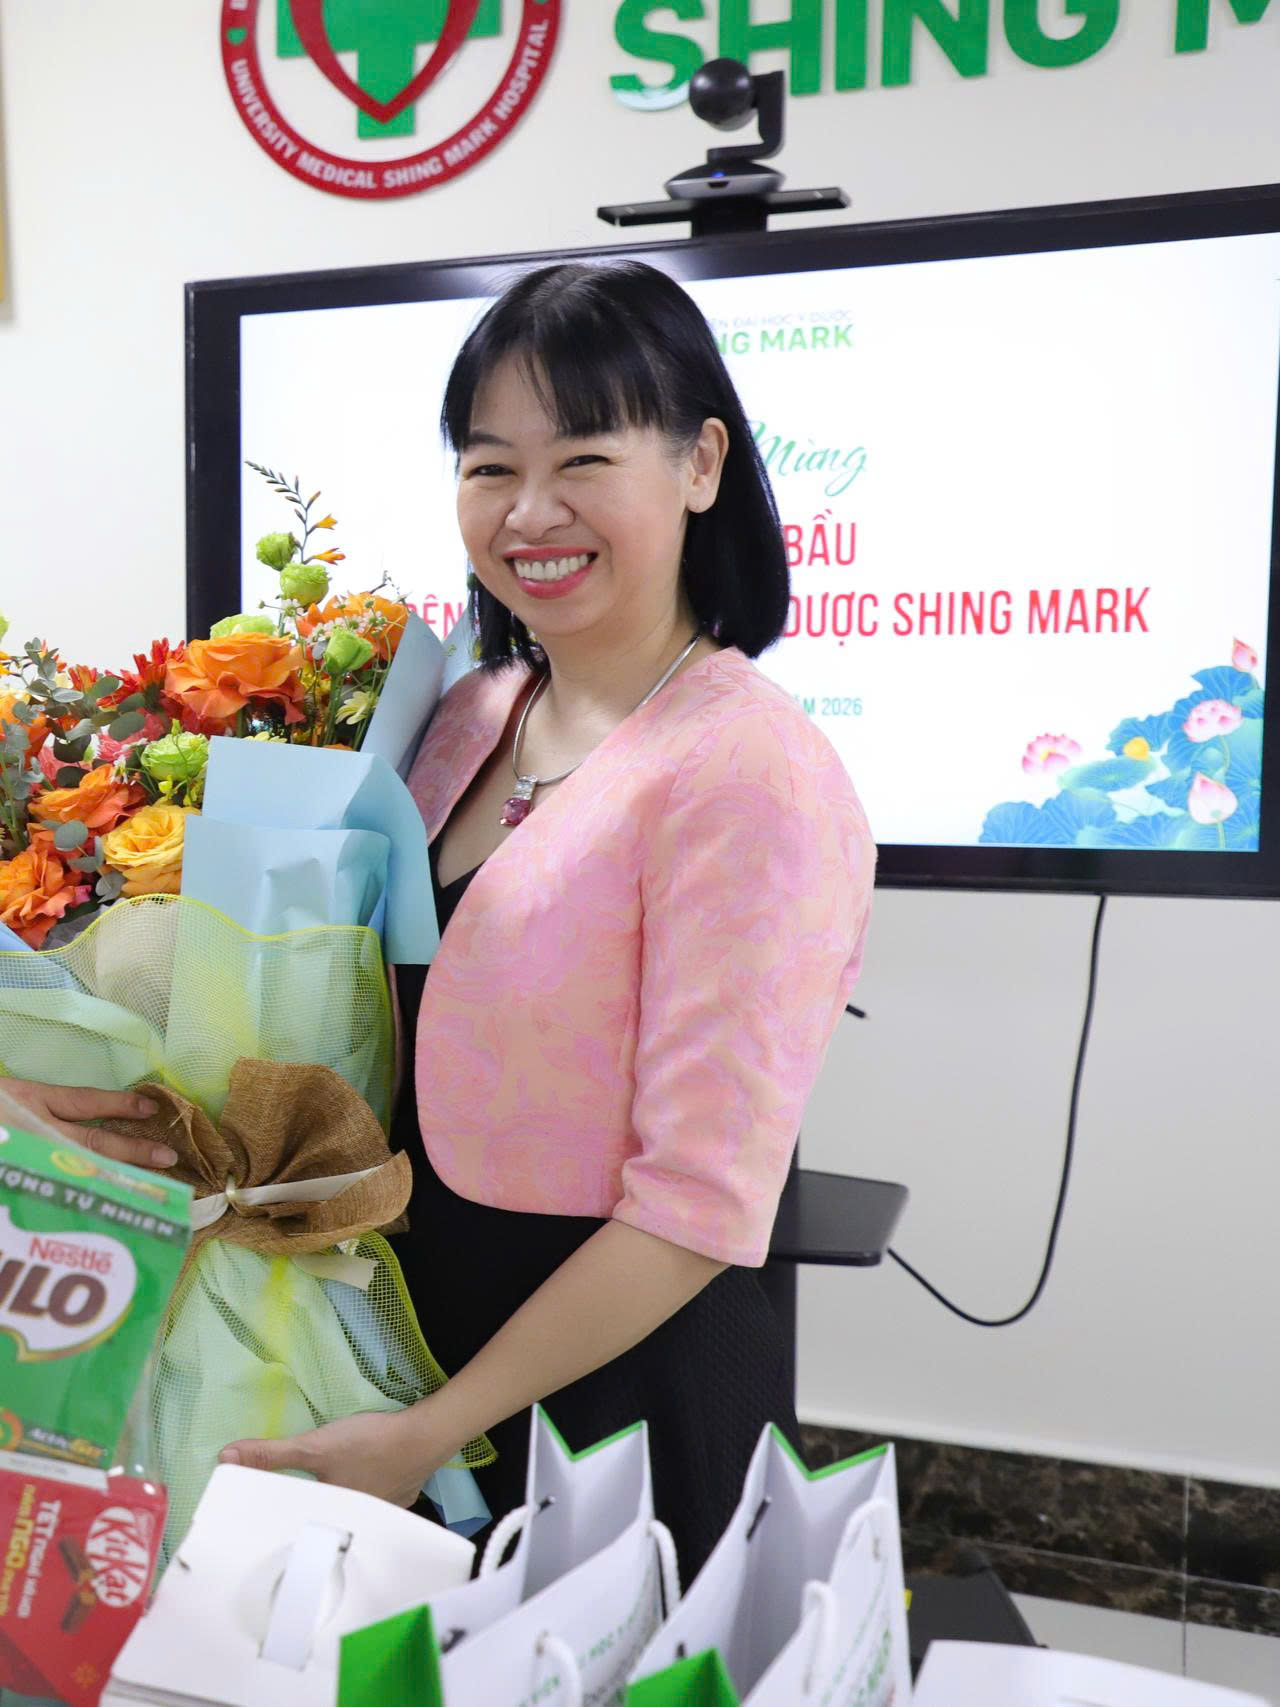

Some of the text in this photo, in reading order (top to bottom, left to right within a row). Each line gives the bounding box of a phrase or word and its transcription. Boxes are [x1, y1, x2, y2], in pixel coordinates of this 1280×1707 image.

[231, 18, 550, 190] UNIVERSITY MEDICAL SHING MARK HOSPITAL
[760, 323, 854, 353] MARK
[783, 508, 856, 567] BẦU
[892, 590, 1013, 637] SHING
[1027, 586, 1151, 635] MARK
[821, 697, 863, 717] 2026
